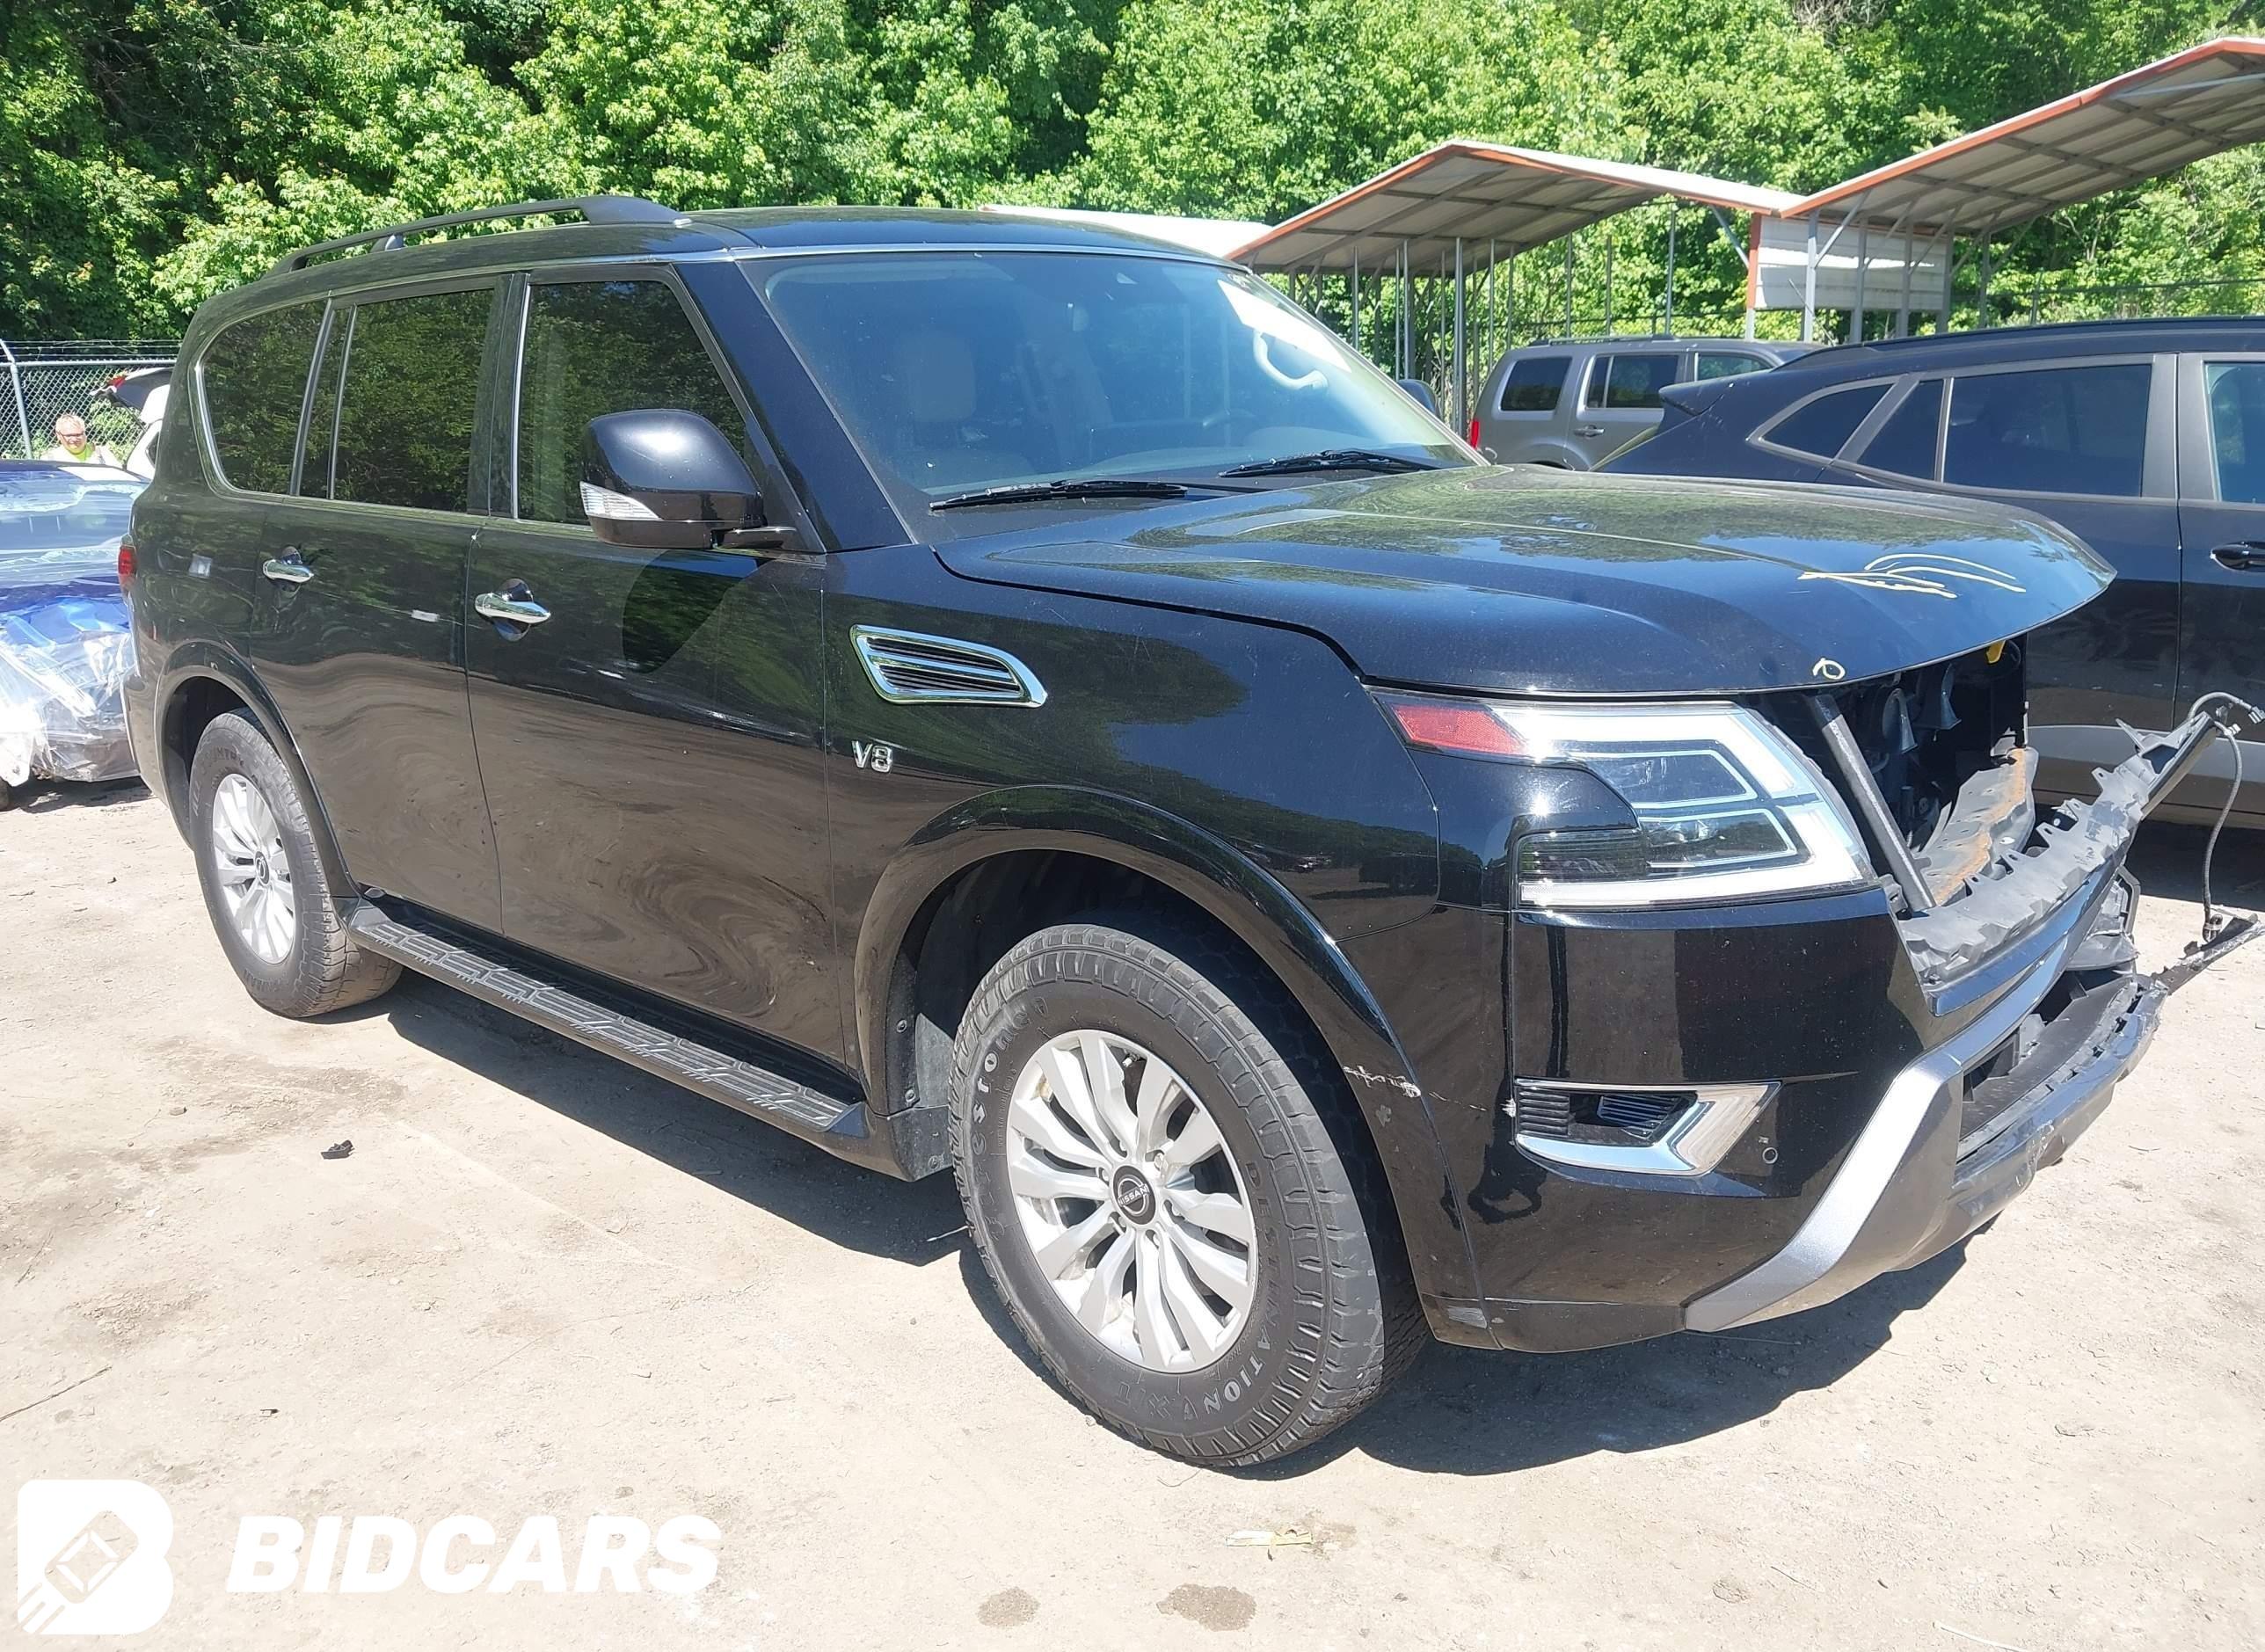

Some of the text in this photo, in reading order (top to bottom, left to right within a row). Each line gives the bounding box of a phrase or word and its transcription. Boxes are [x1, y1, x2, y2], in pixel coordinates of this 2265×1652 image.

[850, 740, 893, 773] V8
[1118, 1183, 1151, 1205] NISSAN
[1203, 1162, 1281, 1415] DESTINATION
